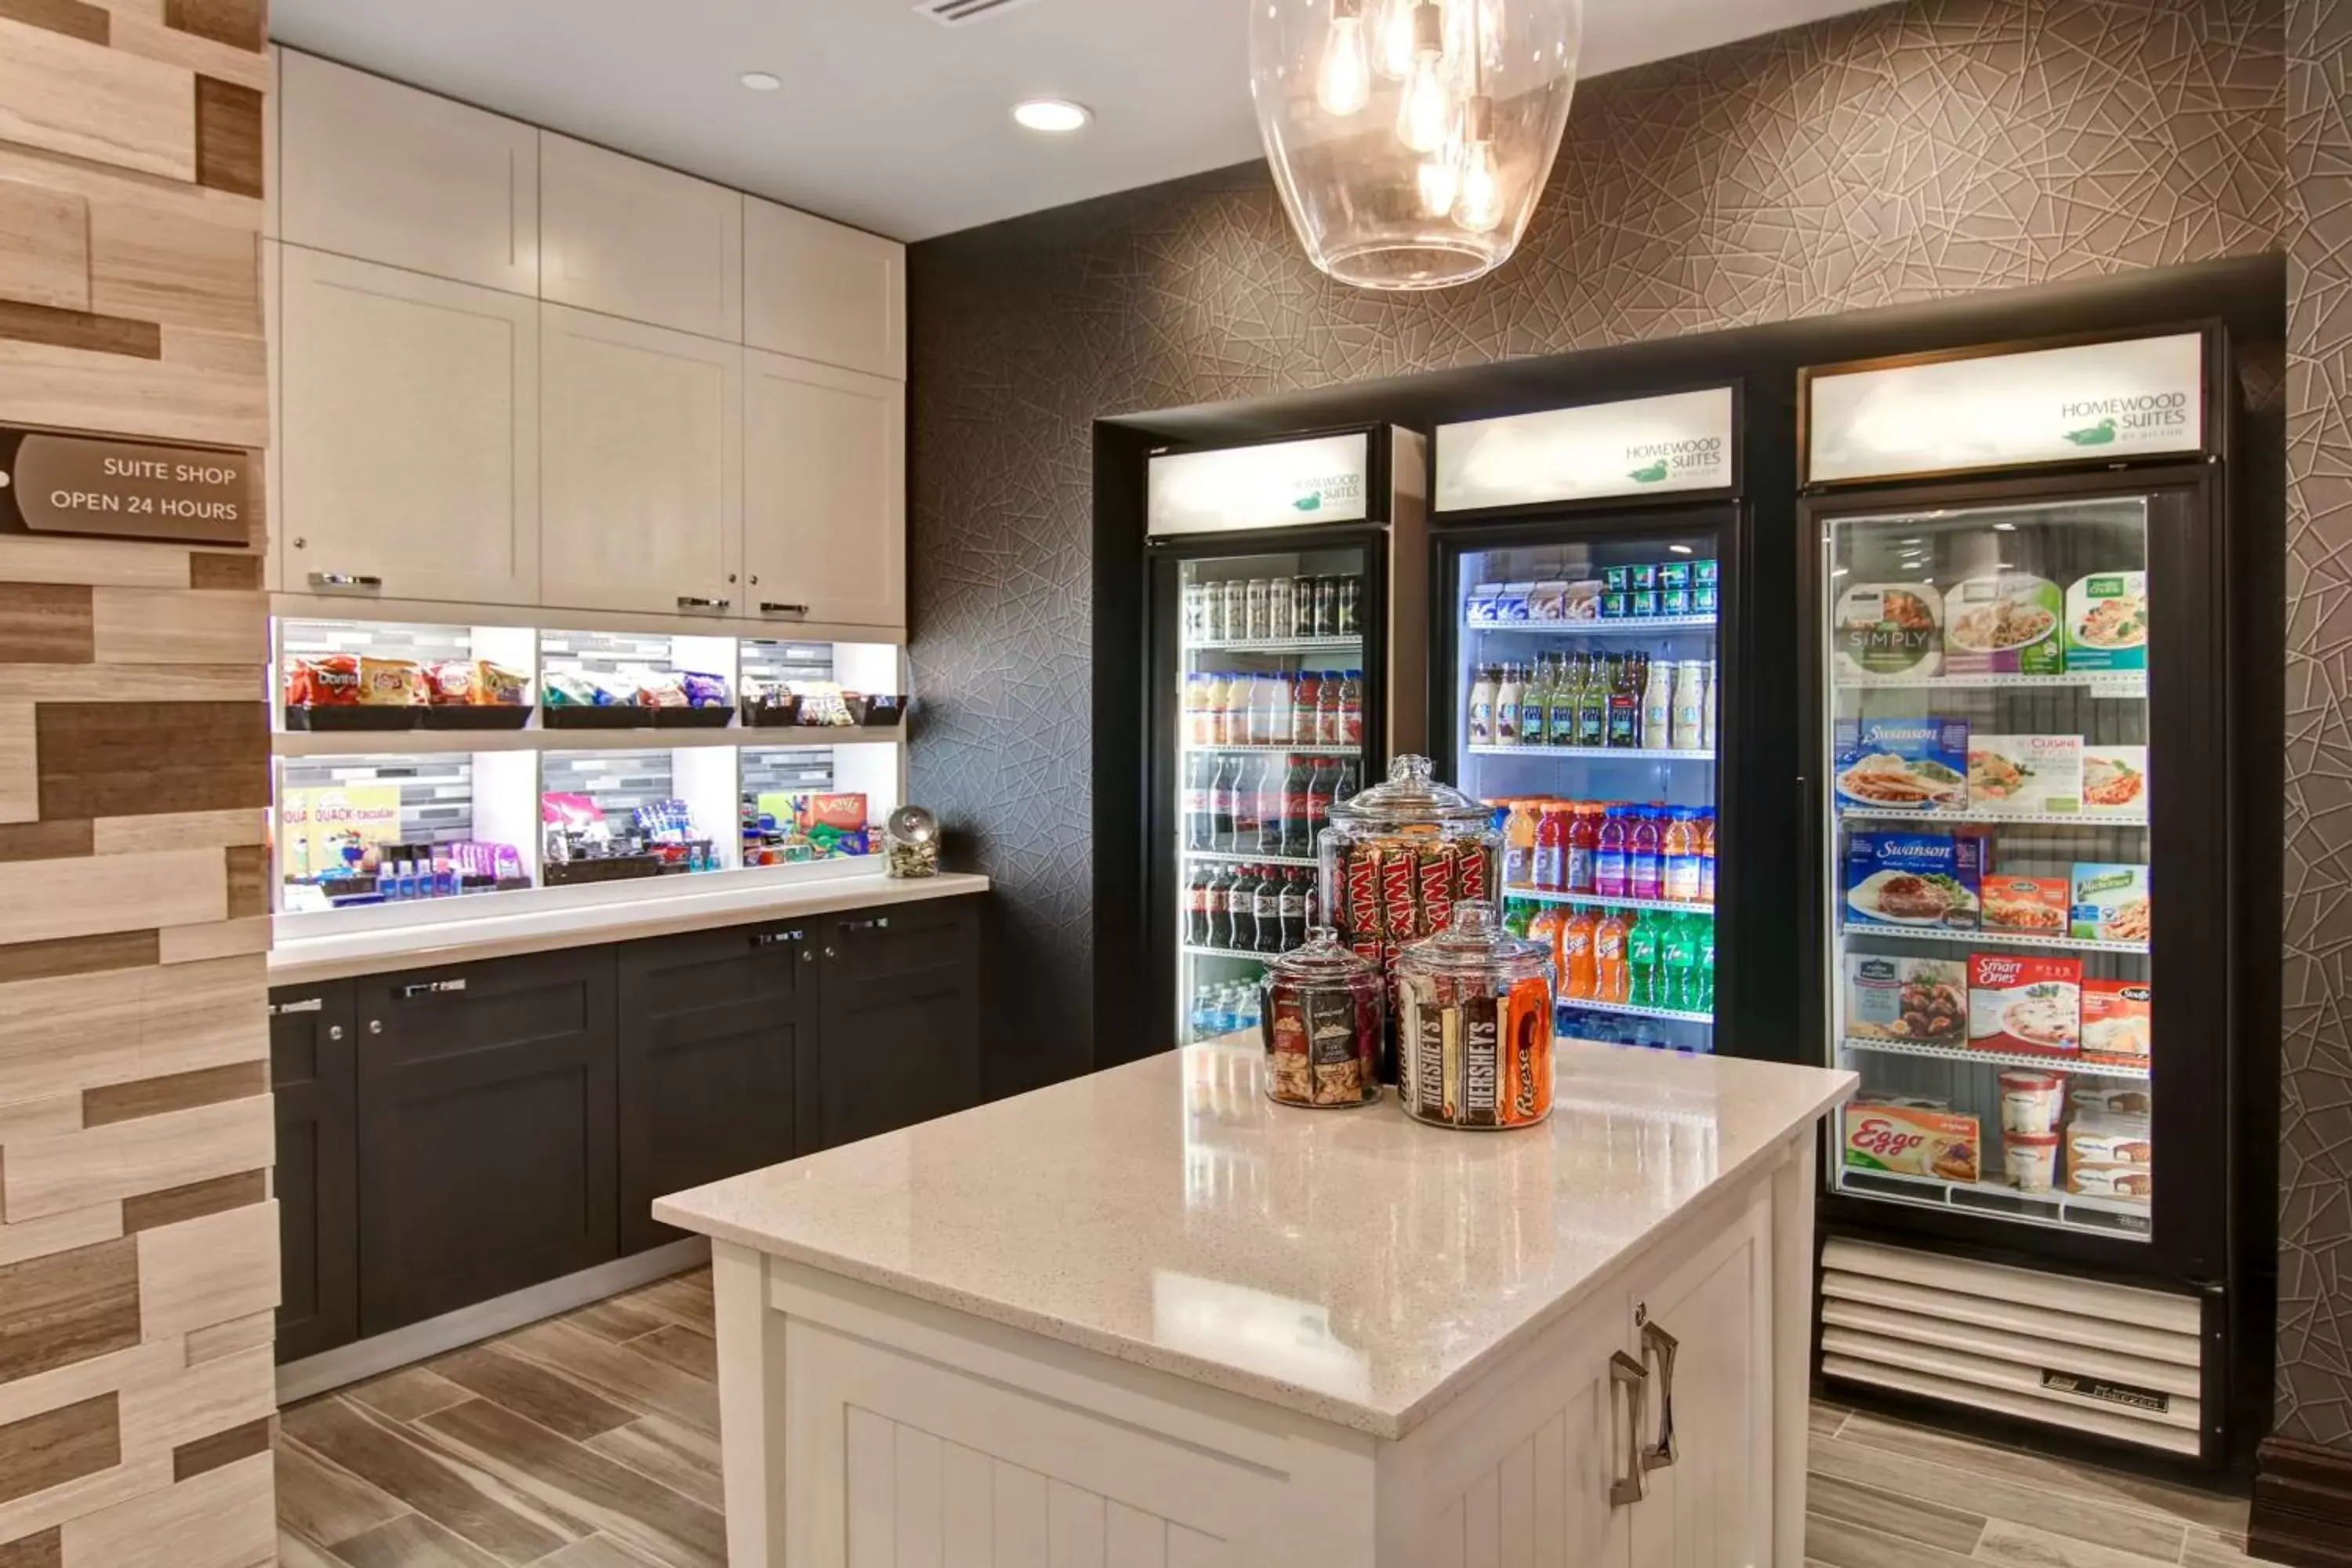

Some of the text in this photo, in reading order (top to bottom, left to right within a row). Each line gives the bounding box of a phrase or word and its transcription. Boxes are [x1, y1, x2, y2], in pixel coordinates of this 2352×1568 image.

[2061, 393, 2187, 419] HOMEWOOD
[2121, 409, 2186, 430] SUITES
[1626, 437, 1722, 459] HOMEWOOD
[103, 457, 237, 485] SUITE SHOP
[1671, 452, 1721, 470] SUITES
[1323, 485, 1359, 499] SUITES
[50, 490, 238, 521] OPEN 24 HOURS
[1849, 630, 1928, 648] SIMPLY
[1864, 725, 1938, 743] Swanson
[1876, 840, 1951, 858] Swanson
[1349, 852, 1378, 933] TWIX
[1382, 851, 1416, 935] TWIX
[1976, 958, 2023, 974] Smart
[1979, 971, 2017, 985] Ones
[1421, 1020, 1442, 1108] HERSHEY'S
[1467, 1021, 1496, 1109] HERSHEY'S
[1850, 1118, 1926, 1156] Eggo
